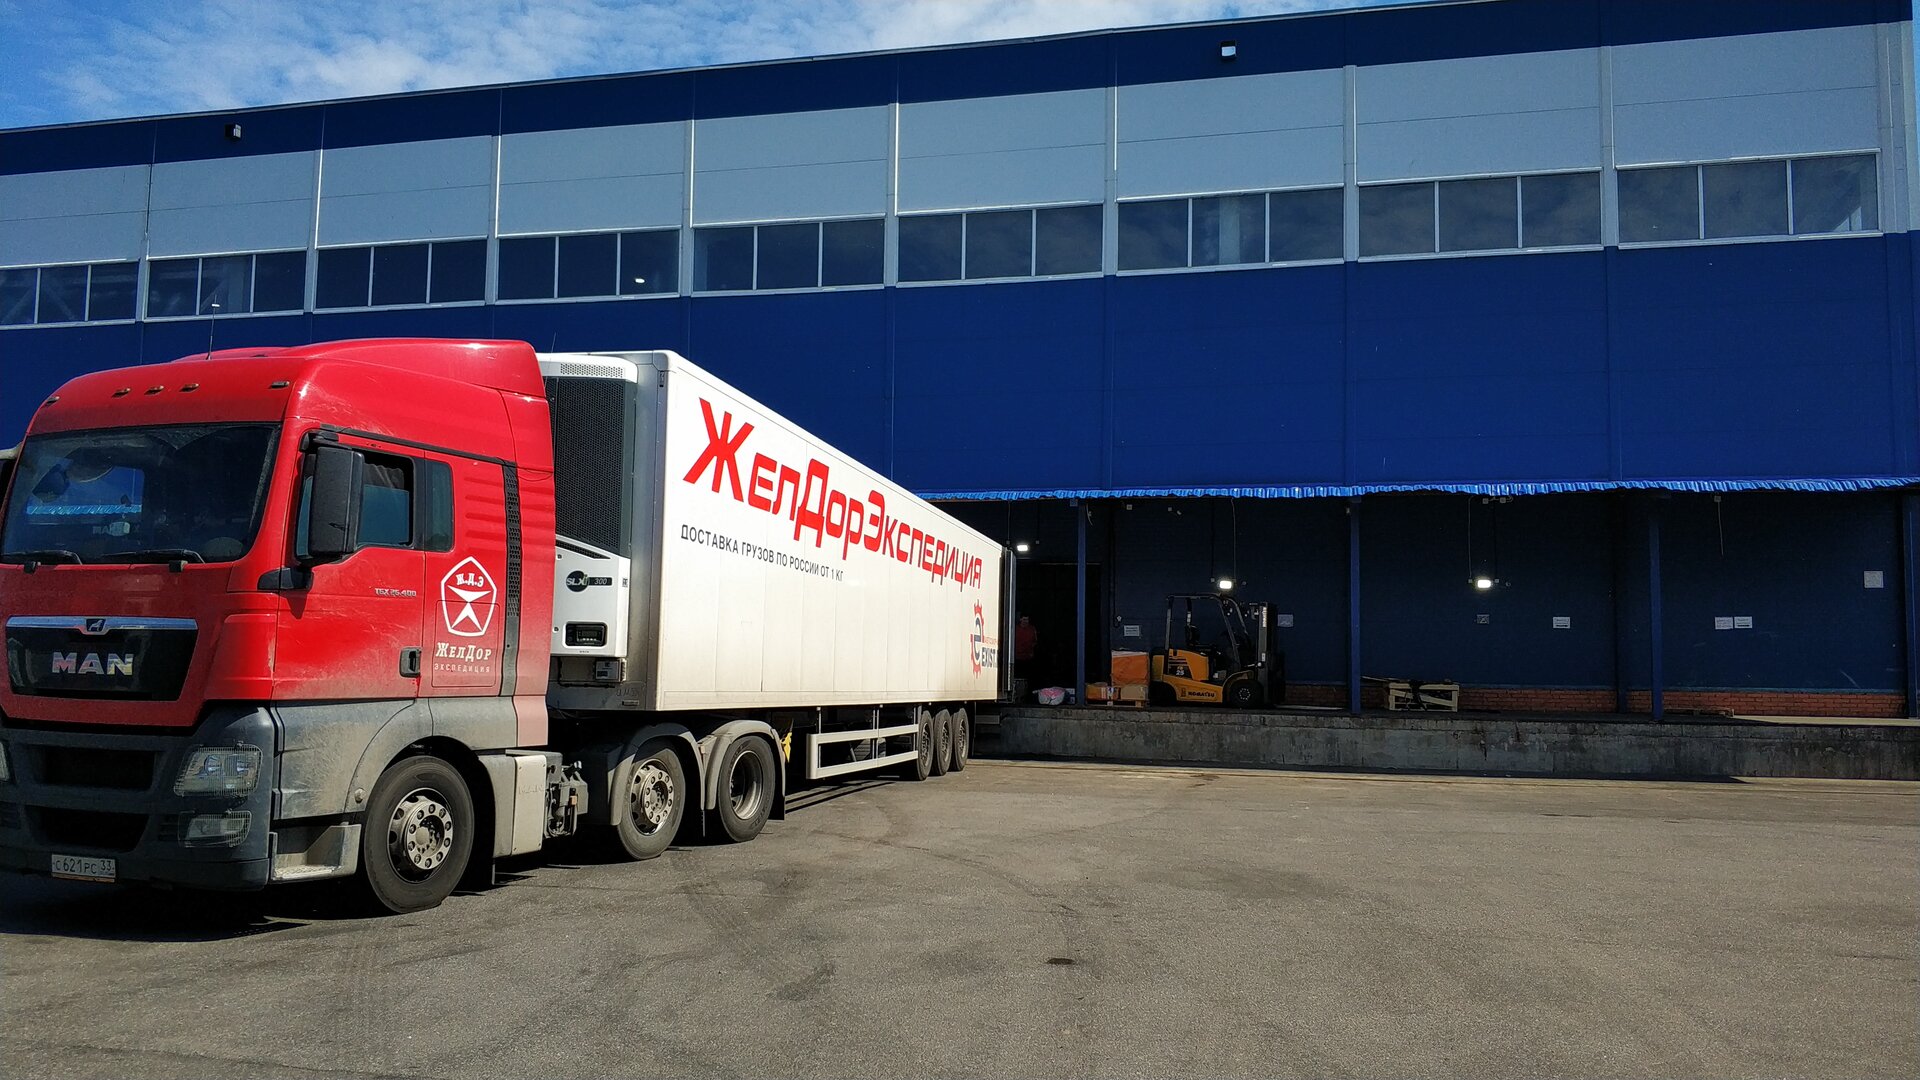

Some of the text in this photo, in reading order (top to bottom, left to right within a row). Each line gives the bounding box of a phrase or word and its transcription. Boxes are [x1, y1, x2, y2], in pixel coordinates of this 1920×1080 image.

[681, 524, 739, 554] ДОСТАВКА
[741, 542, 774, 563] ГРУЗОВ
[776, 552, 788, 567] ПО
[789, 556, 819, 576] РОССИИ
[820, 565, 830, 578] ОТ
[835, 569, 844, 582] КГ
[51, 652, 134, 676] MAN
[434, 663, 491, 673] ЭКСПЕДИЦИЯ
